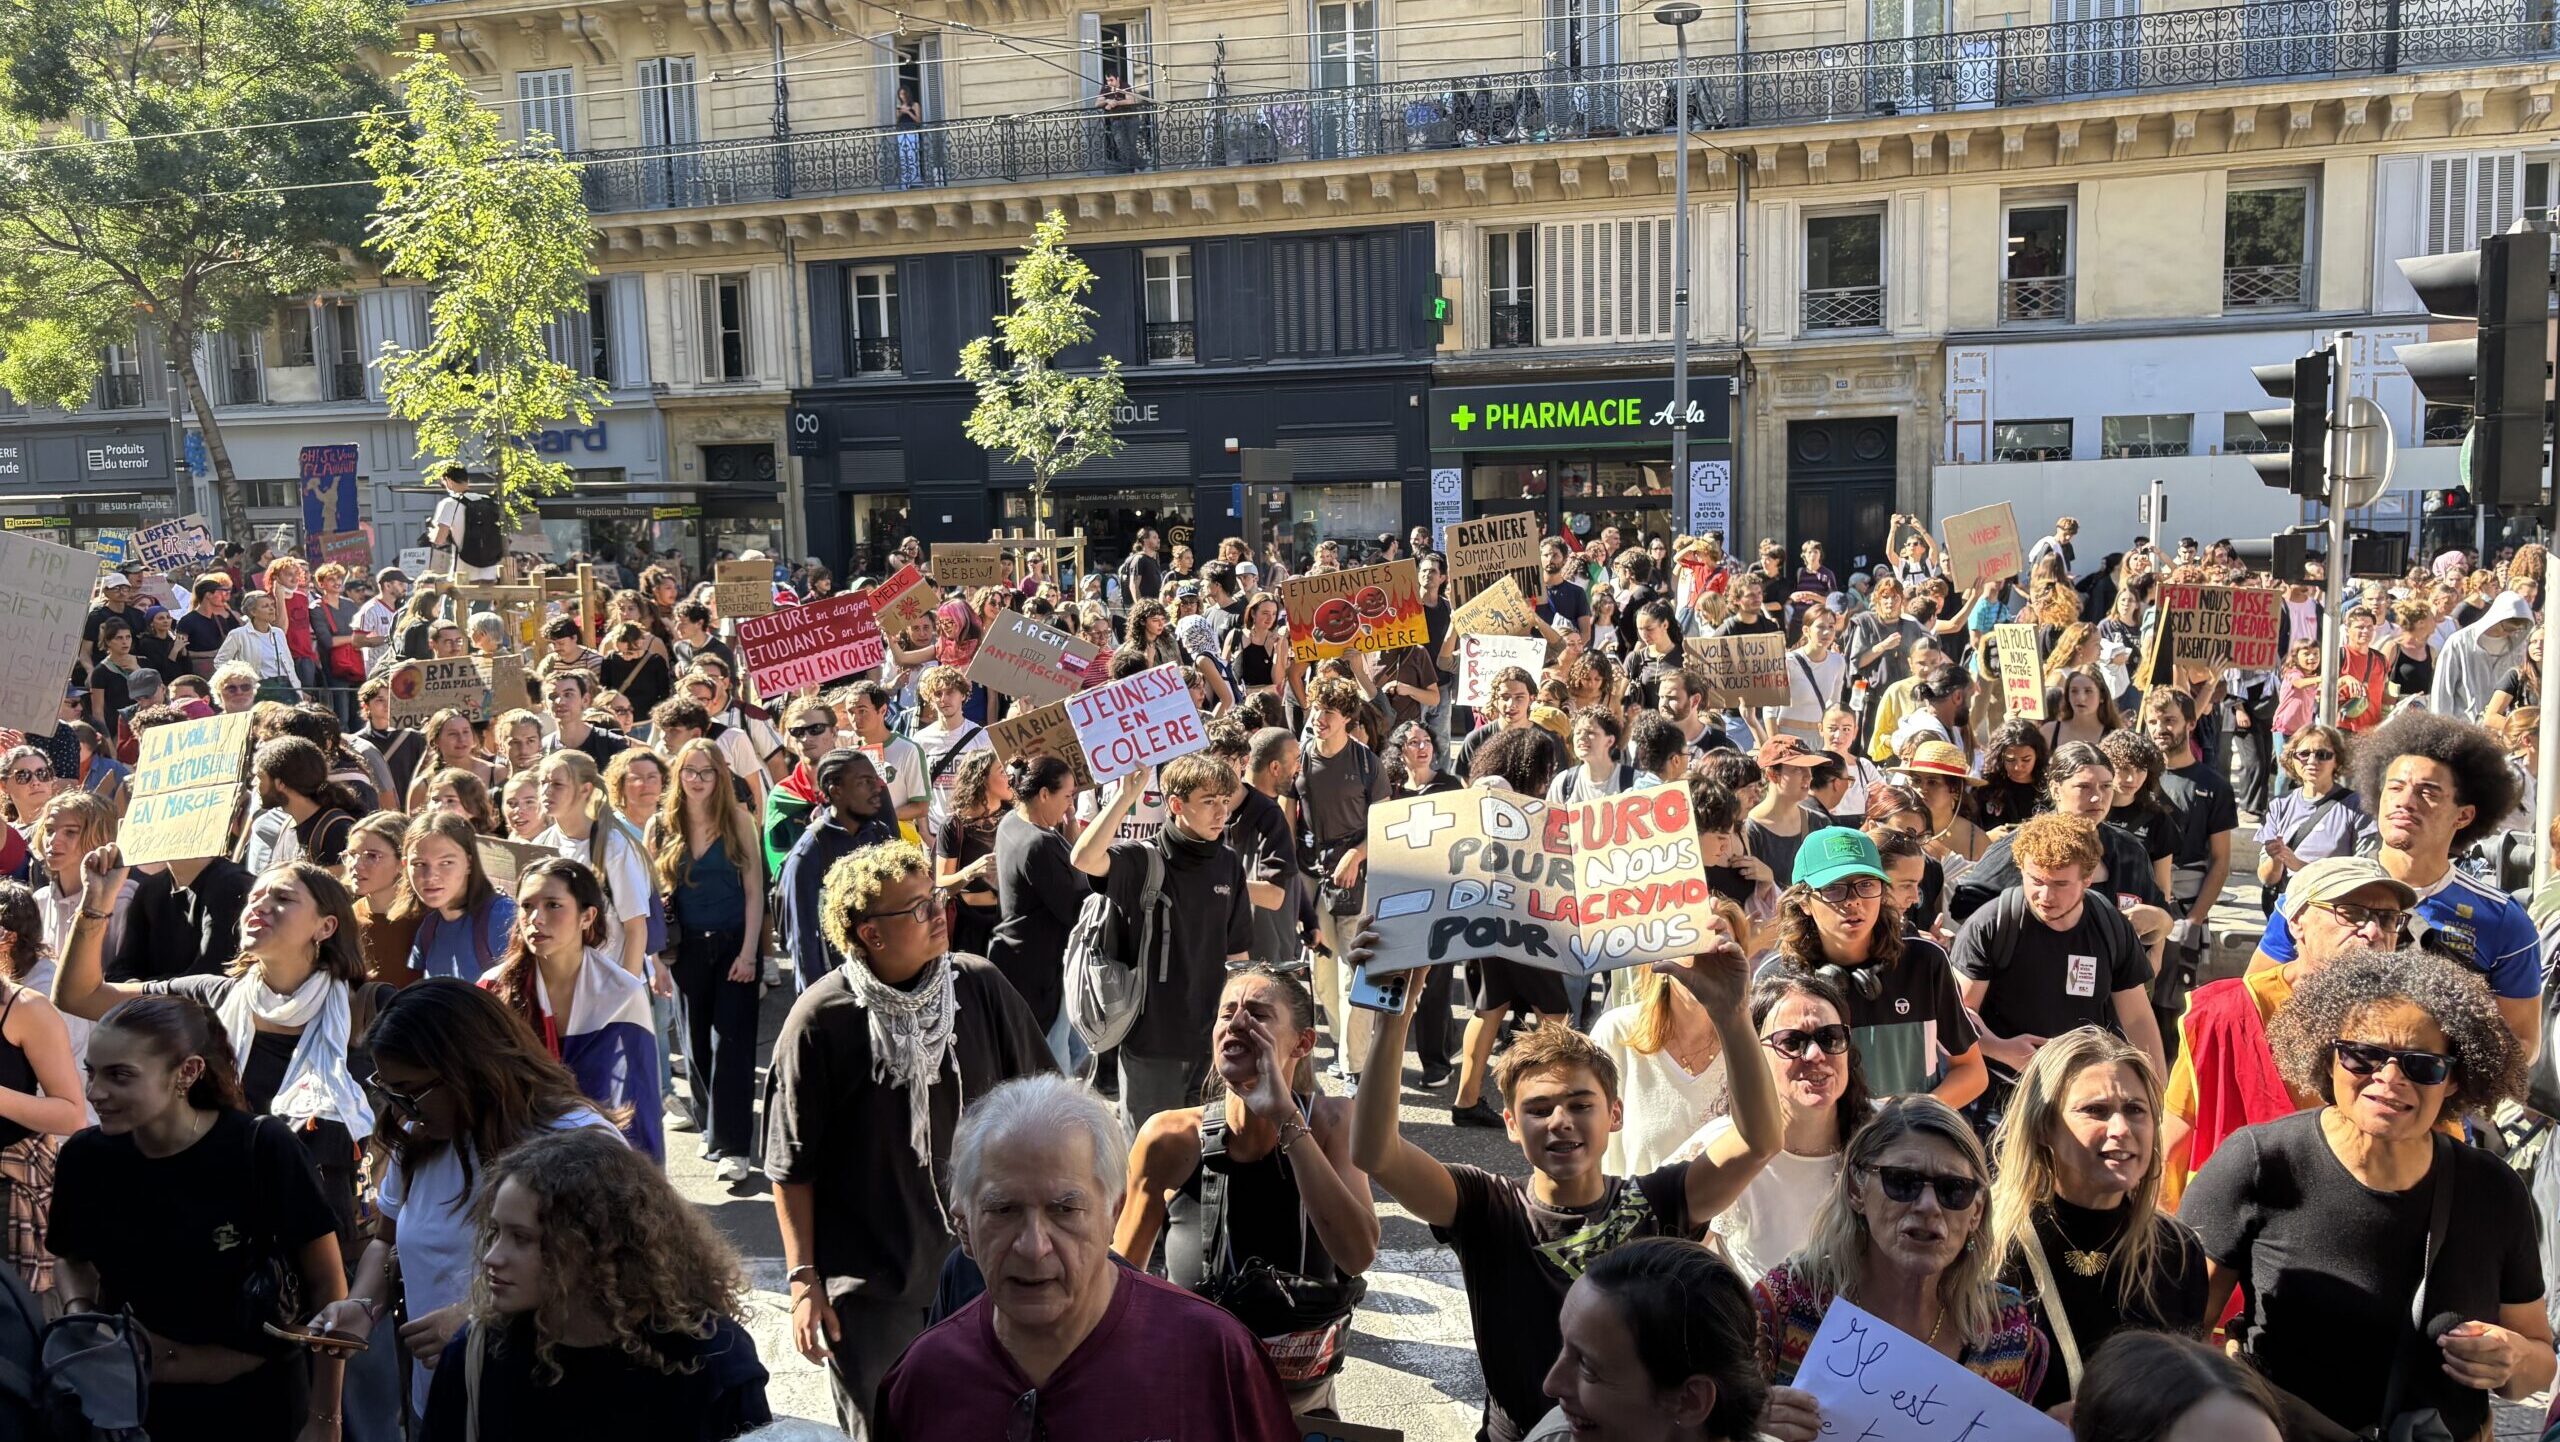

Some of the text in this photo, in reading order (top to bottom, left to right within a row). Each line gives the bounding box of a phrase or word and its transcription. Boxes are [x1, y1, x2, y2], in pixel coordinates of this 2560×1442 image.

[1486, 398, 1706, 430] PHARMACIE Ala
[105, 458, 149, 469] du terroir
[106, 445, 145, 455] Produits
[112, 502, 127, 510] suis
[577, 507, 621, 518] République
[1458, 517, 1528, 547] DERNIERE
[1455, 540, 1527, 567] SOMMATION
[1477, 560, 1506, 572] AVANT
[874, 574, 909, 605] MEDIC
[2200, 590, 2231, 612] NOUS
[2232, 591, 2274, 616] PISSE
[741, 598, 871, 642] CULTURE en danger
[1011, 620, 1070, 651] ARCHI
[2200, 611, 2213, 634] ET
[2215, 612, 2232, 634] LES
[747, 625, 836, 667] ETUDIANTS
[841, 628, 855, 639] en
[1296, 627, 1418, 661] EN COLÈRE
[1700, 641, 1765, 658] VOUS NOUS
[1998, 627, 2010, 650] LA
[2177, 637, 2213, 659] DISENT
[2233, 642, 2277, 667] PLEUT
[425, 662, 455, 681] RN
[759, 640, 885, 696] ARCHI EN COLÈRE
[984, 644, 1079, 693] ANTIFASCISTE
[1720, 675, 1750, 690] VOUS
[1071, 664, 1184, 728] JEUNESSE
[1117, 709, 1150, 734] EN
[149, 731, 173, 763] LA
[1091, 714, 1199, 774] COLERE
[140, 769, 161, 792] TA
[132, 788, 226, 824] EN MARCHE
[1479, 789, 1690, 855] D'EURO
[1448, 837, 1699, 891] POUR NOUS
[1447, 879, 1515, 911] DE
[1528, 879, 1708, 926] LACRYMO
[1427, 913, 1699, 970] POUR VOUS
[1890, 1384, 1949, 1426] est
